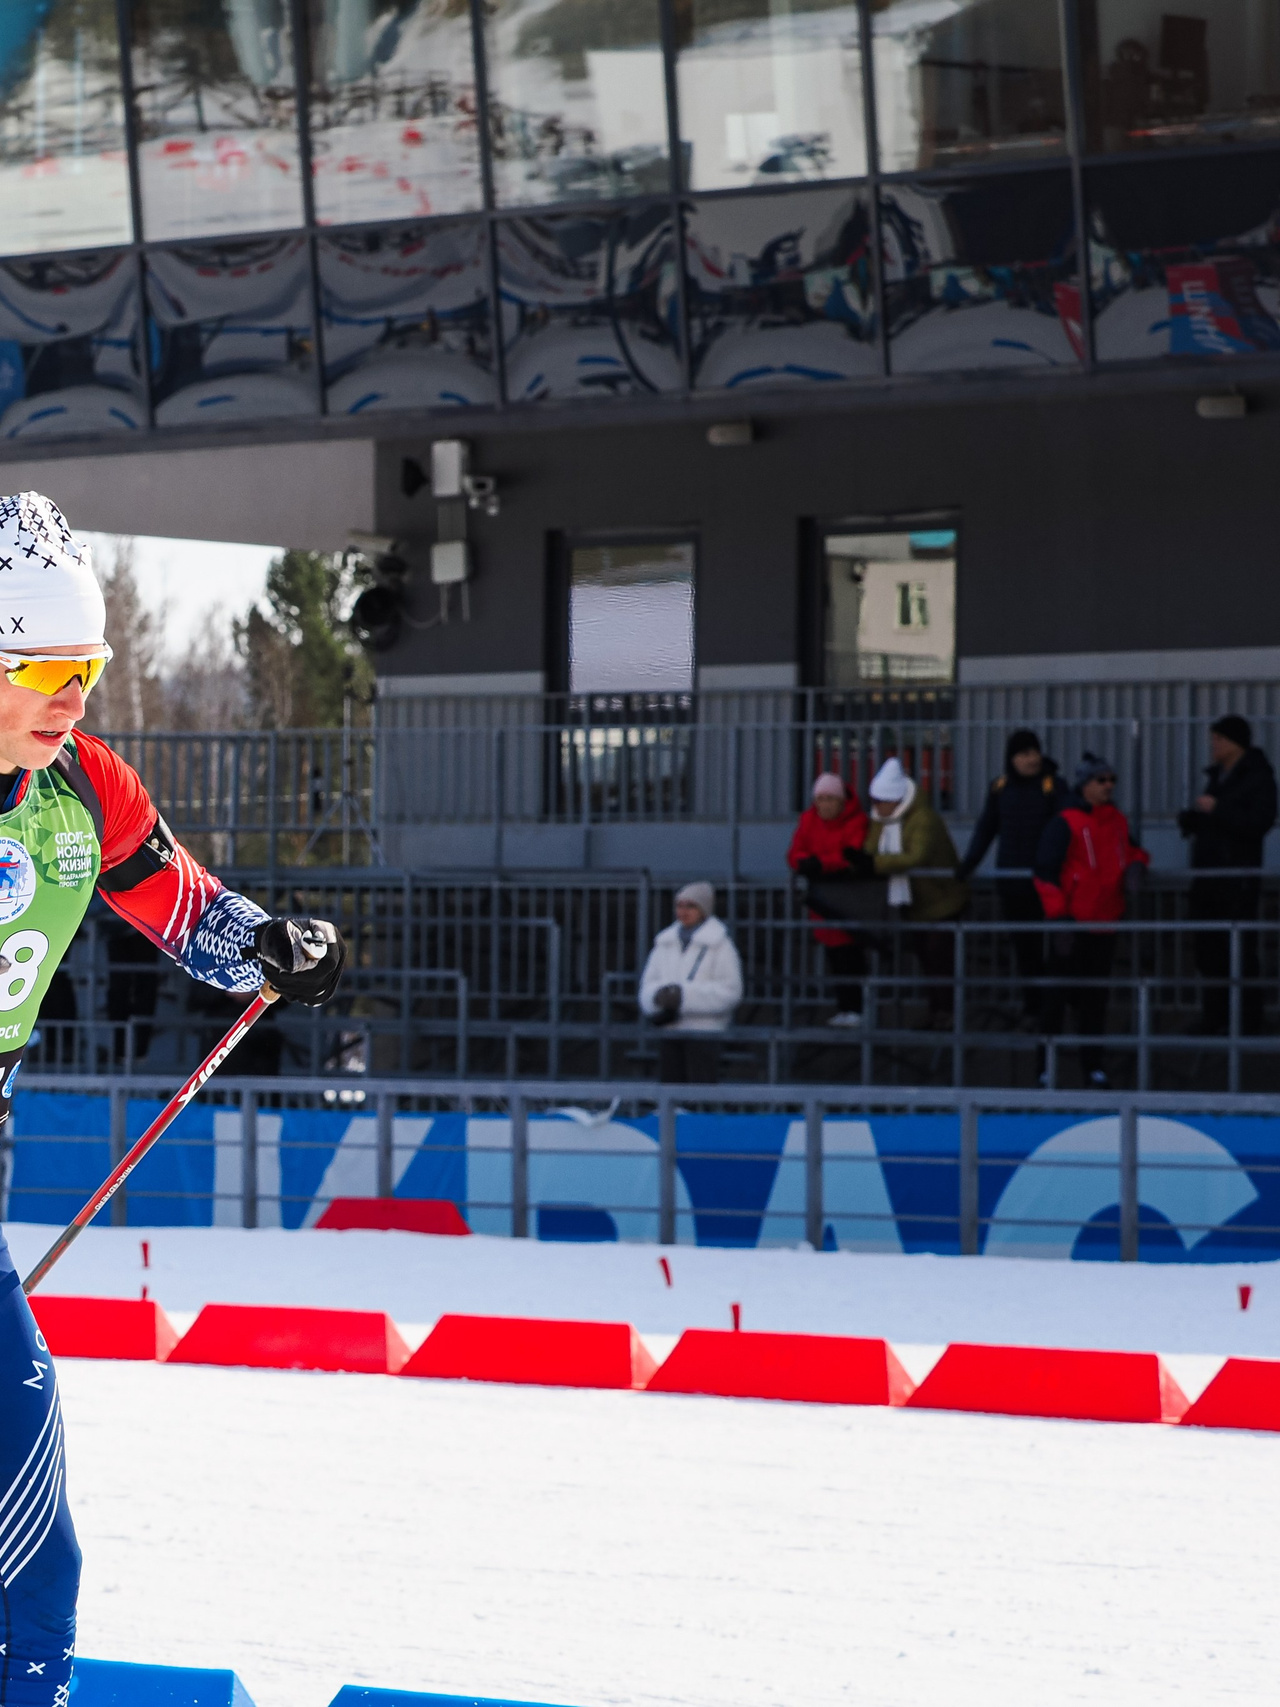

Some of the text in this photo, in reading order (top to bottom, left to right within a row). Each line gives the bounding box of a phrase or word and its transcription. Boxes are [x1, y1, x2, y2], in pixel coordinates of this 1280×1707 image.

[55, 831, 84, 845] СПОРТ
[56, 843, 92, 859] НОРМА
[58, 857, 92, 872] ЖИЗНИ
[58, 880, 78, 888] ПРОЕКТ
